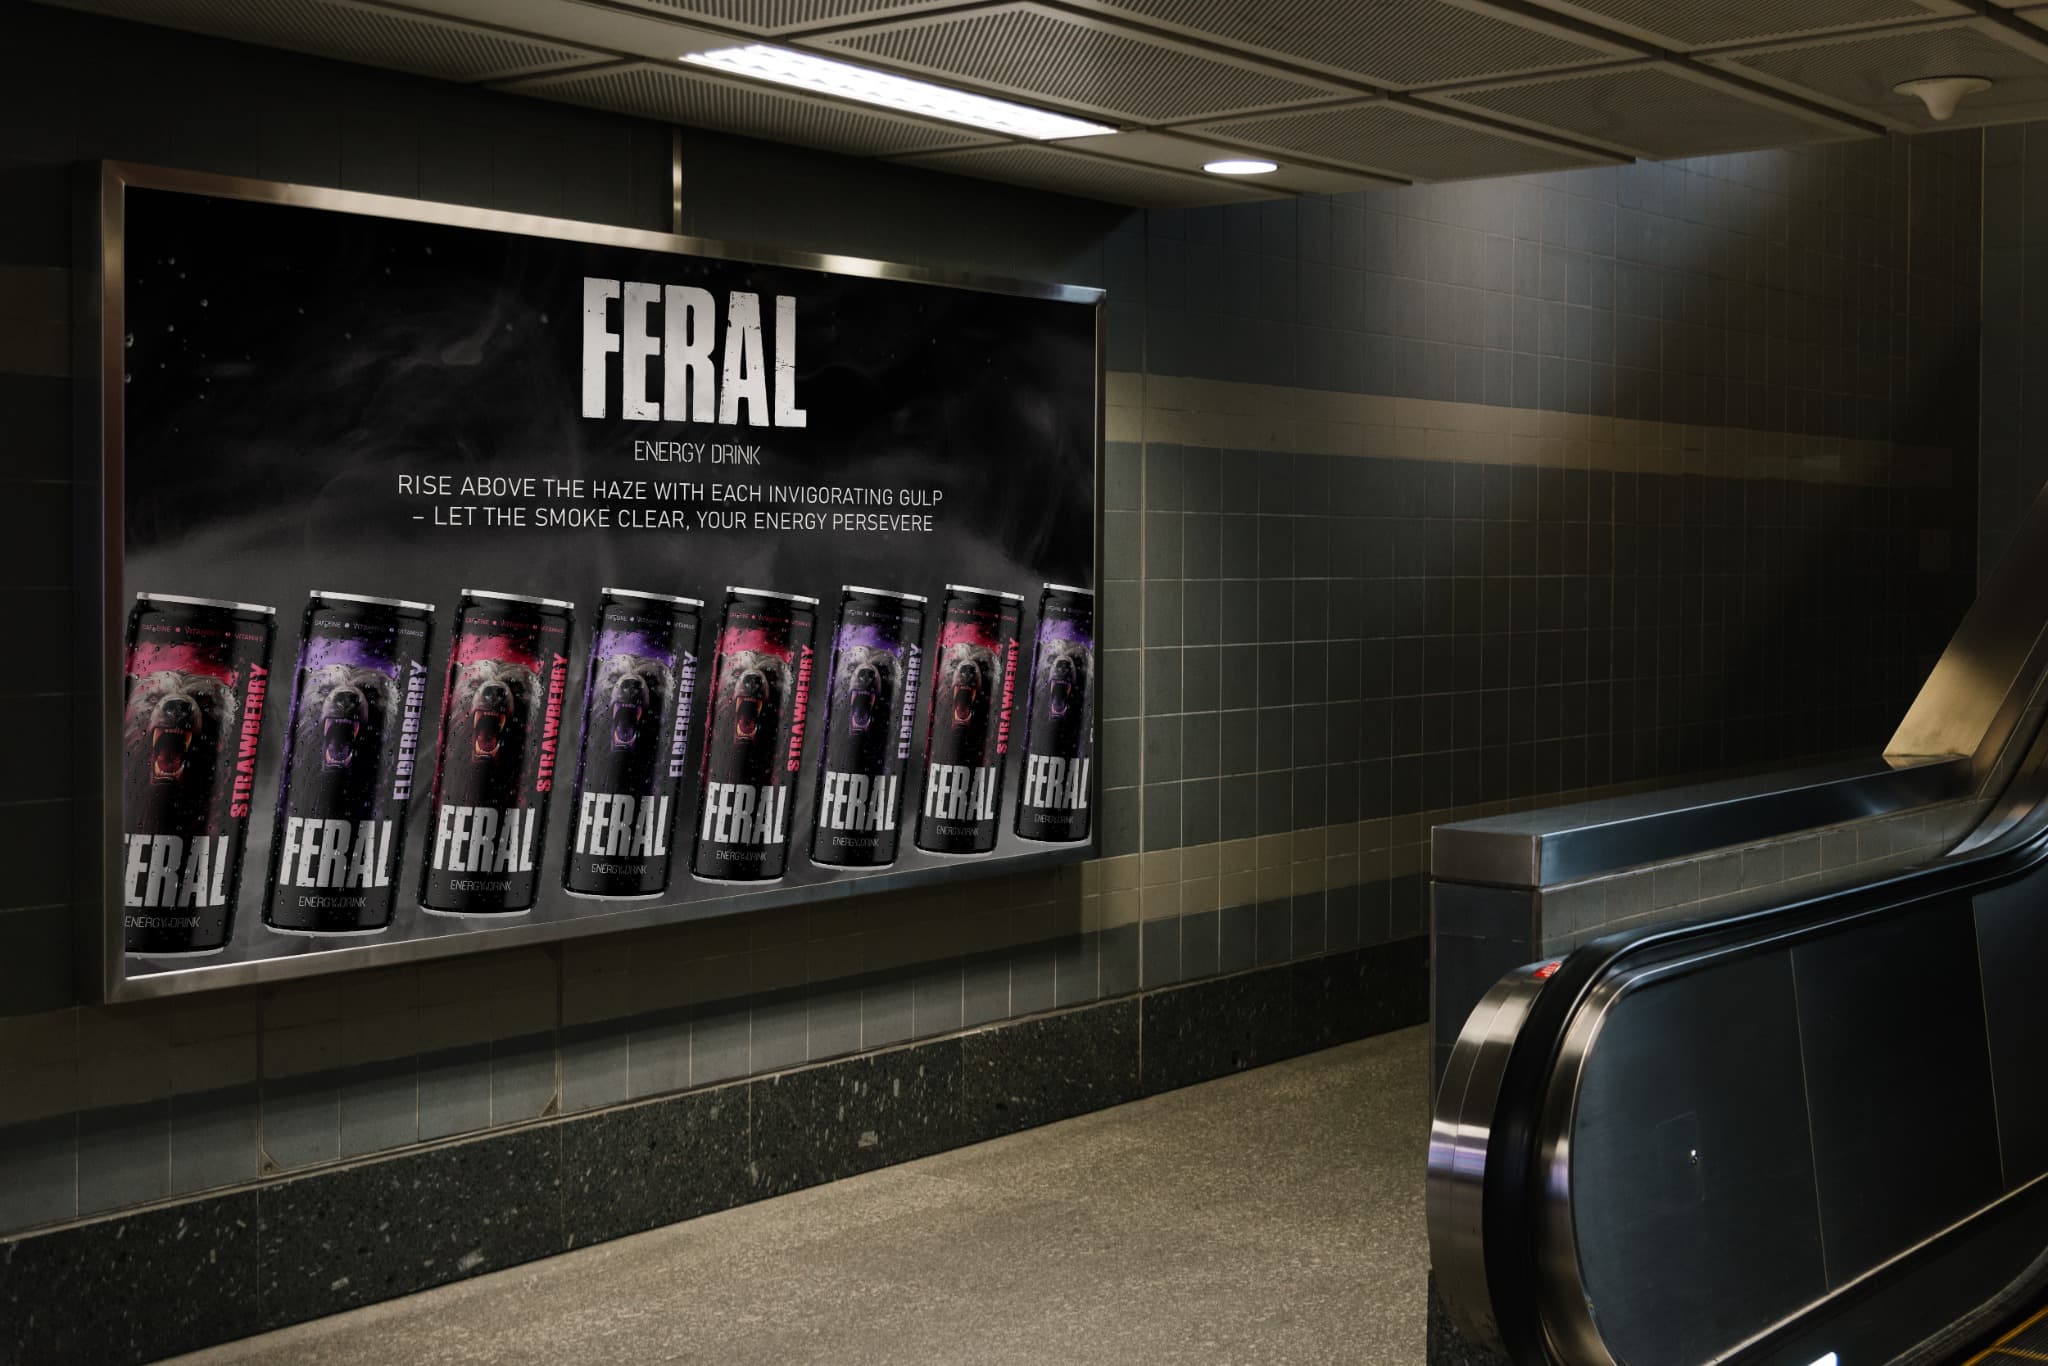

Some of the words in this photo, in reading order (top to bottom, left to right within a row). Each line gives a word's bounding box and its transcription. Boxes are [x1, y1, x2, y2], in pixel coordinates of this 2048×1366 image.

[582, 276, 807, 428] FERAL
[634, 440, 704, 464] ENERGY
[711, 443, 761, 466] DRINK
[398, 474, 452, 496] RISE
[460, 476, 537, 498] ABOVE
[543, 479, 584, 499] THE
[593, 480, 647, 500] HAZE
[654, 481, 704, 502] WITH
[712, 483, 761, 503] EACH
[769, 485, 893, 505] INVIGORATING
[900, 488, 943, 507] GULP
[433, 506, 477, 527] LET
[485, 507, 526, 526] THE
[535, 508, 612, 529] SMOKE
[618, 509, 690, 531] CLEAR,
[697, 510, 748, 530] YOUR
[754, 511, 827, 531] ENERGY
[832, 513, 933, 533] PERSEVERE
[393, 660, 428, 800] ELDERBERRY
[536, 651, 568, 792] STRAWBERRY
[669, 650, 698, 778] ELDERBERRY
[787, 643, 814, 772] STRAWBERRY
[897, 642, 922, 760] ELDERBERRY
[997, 637, 1020, 756] STRAWBERRY
[230, 661, 268, 818] STRAWBERRY
[702, 781, 787, 844] FERAL
[820, 771, 897, 831] FERAL
[925, 763, 997, 820] FERAL
[1023, 754, 1089, 810] FERAL
[279, 816, 393, 888] FERAL
[433, 804, 535, 872] FERAL
[576, 791, 669, 857] FERAL
[125, 833, 230, 907] ERAL
[298, 896, 336, 908] ENERGY
[338, 897, 367, 908] DRINK
[450, 879, 484, 891] ENERGY
[125, 915, 166, 928] ENERGY
